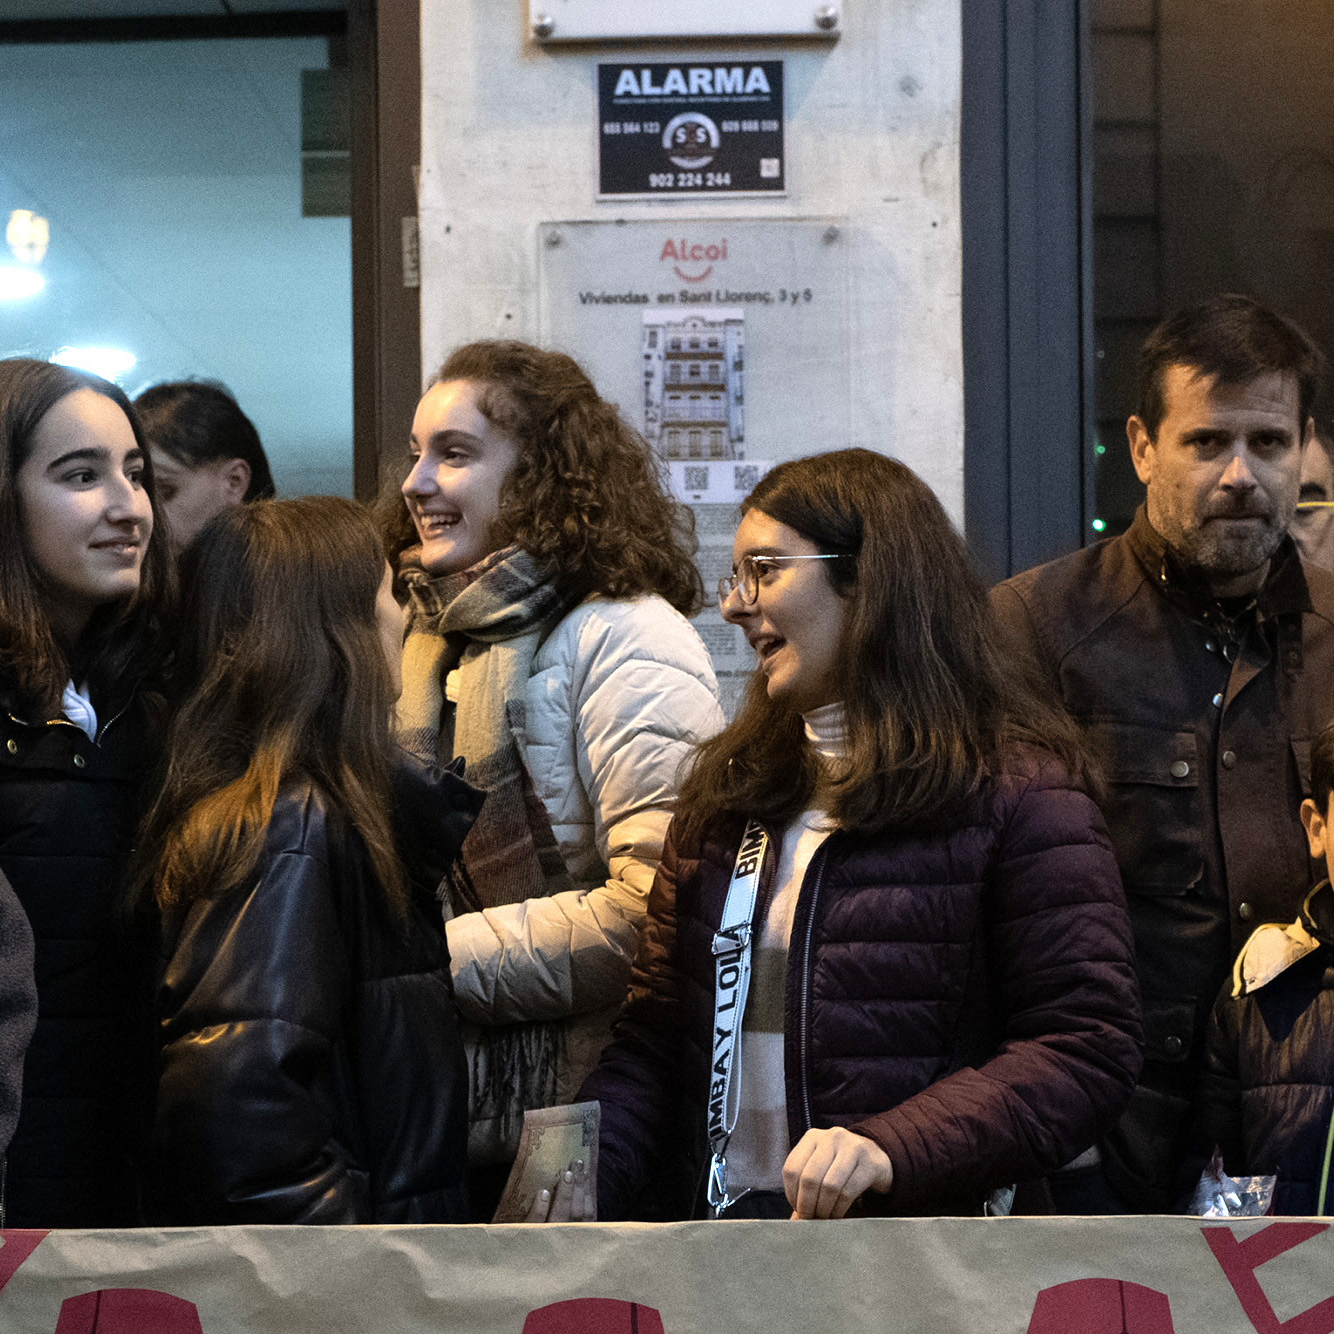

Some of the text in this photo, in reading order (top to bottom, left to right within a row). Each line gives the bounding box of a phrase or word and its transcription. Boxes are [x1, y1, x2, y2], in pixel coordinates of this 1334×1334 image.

[614, 66, 771, 96] ALARMA
[649, 172, 731, 187] 902 224 244
[659, 237, 729, 262] Alcoi
[579, 290, 649, 304] Viviendas
[657, 291, 675, 303] en
[679, 289, 712, 303] Sant
[779, 289, 788, 301] 3
[790, 291, 799, 305] y
